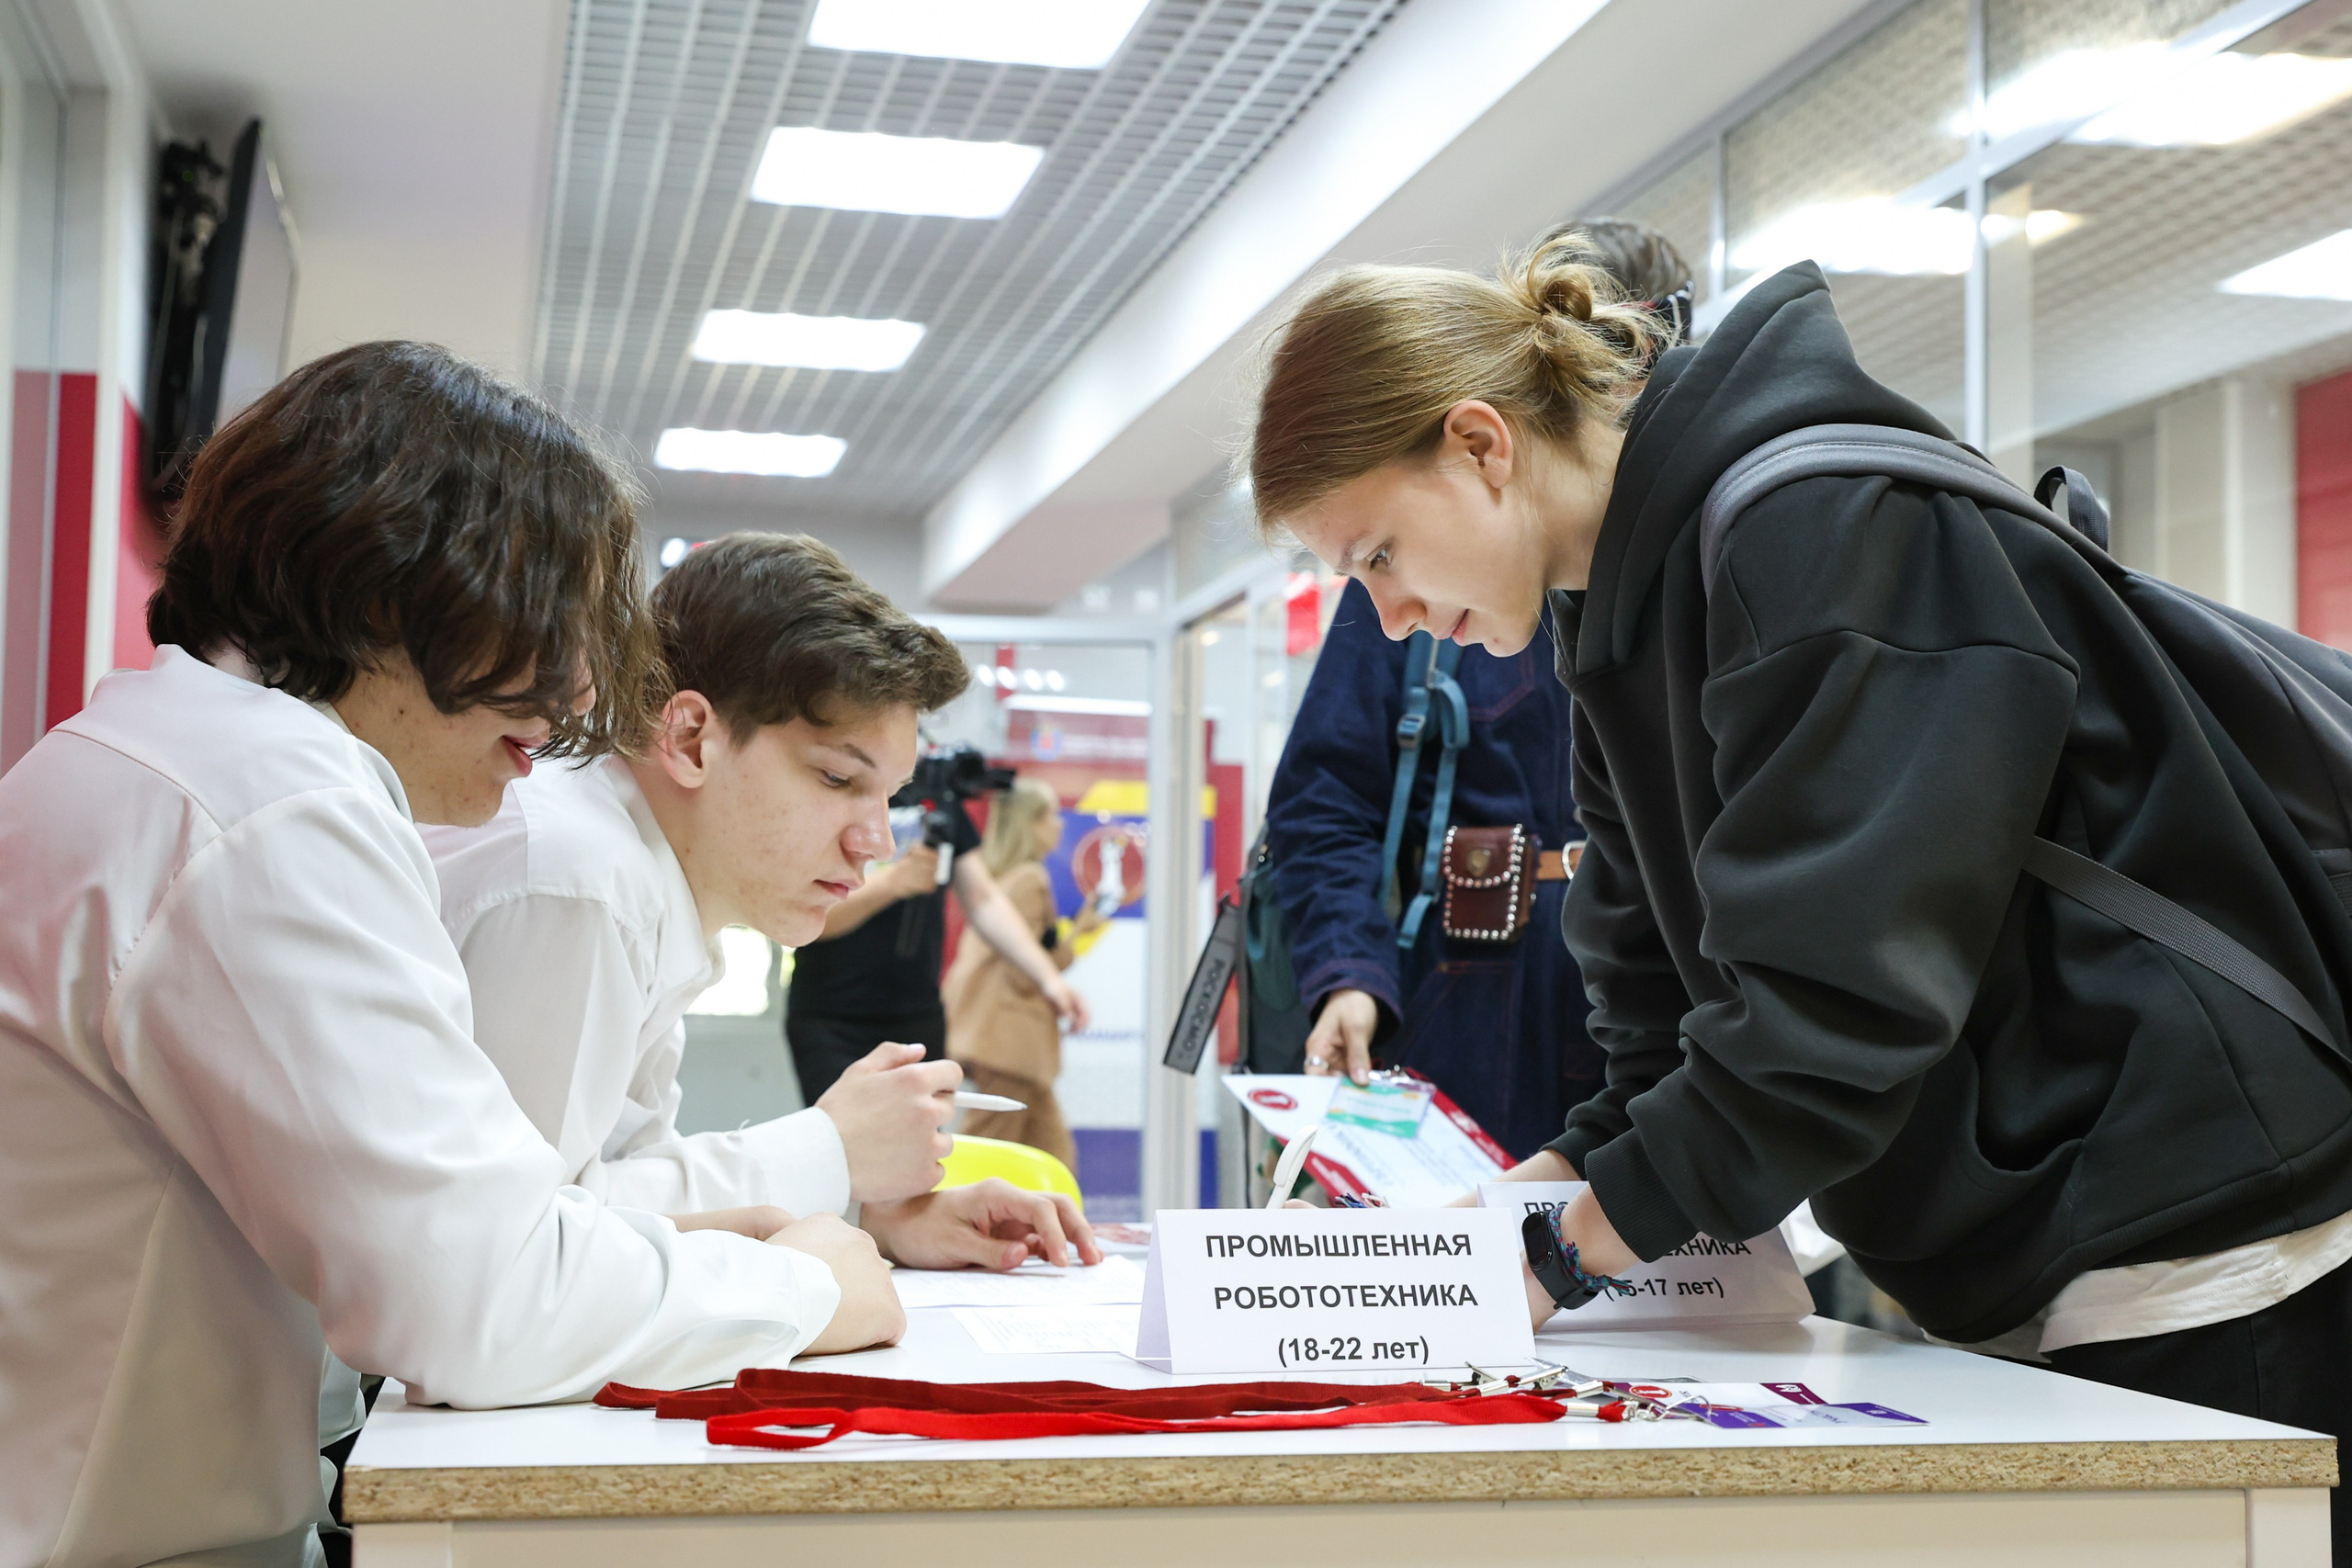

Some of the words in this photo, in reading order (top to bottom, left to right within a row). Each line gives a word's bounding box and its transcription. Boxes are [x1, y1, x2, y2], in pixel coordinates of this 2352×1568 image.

[1205, 1234, 1472, 1258] ПРОМЫШЛЕННАЯ
[1214, 1283, 1479, 1310] РОБОТОТЕХНИКА
[1677, 1277, 1724, 1299] лет)
[1278, 1337, 1363, 1368] (18-22
[1372, 1335, 1430, 1365] лет)
